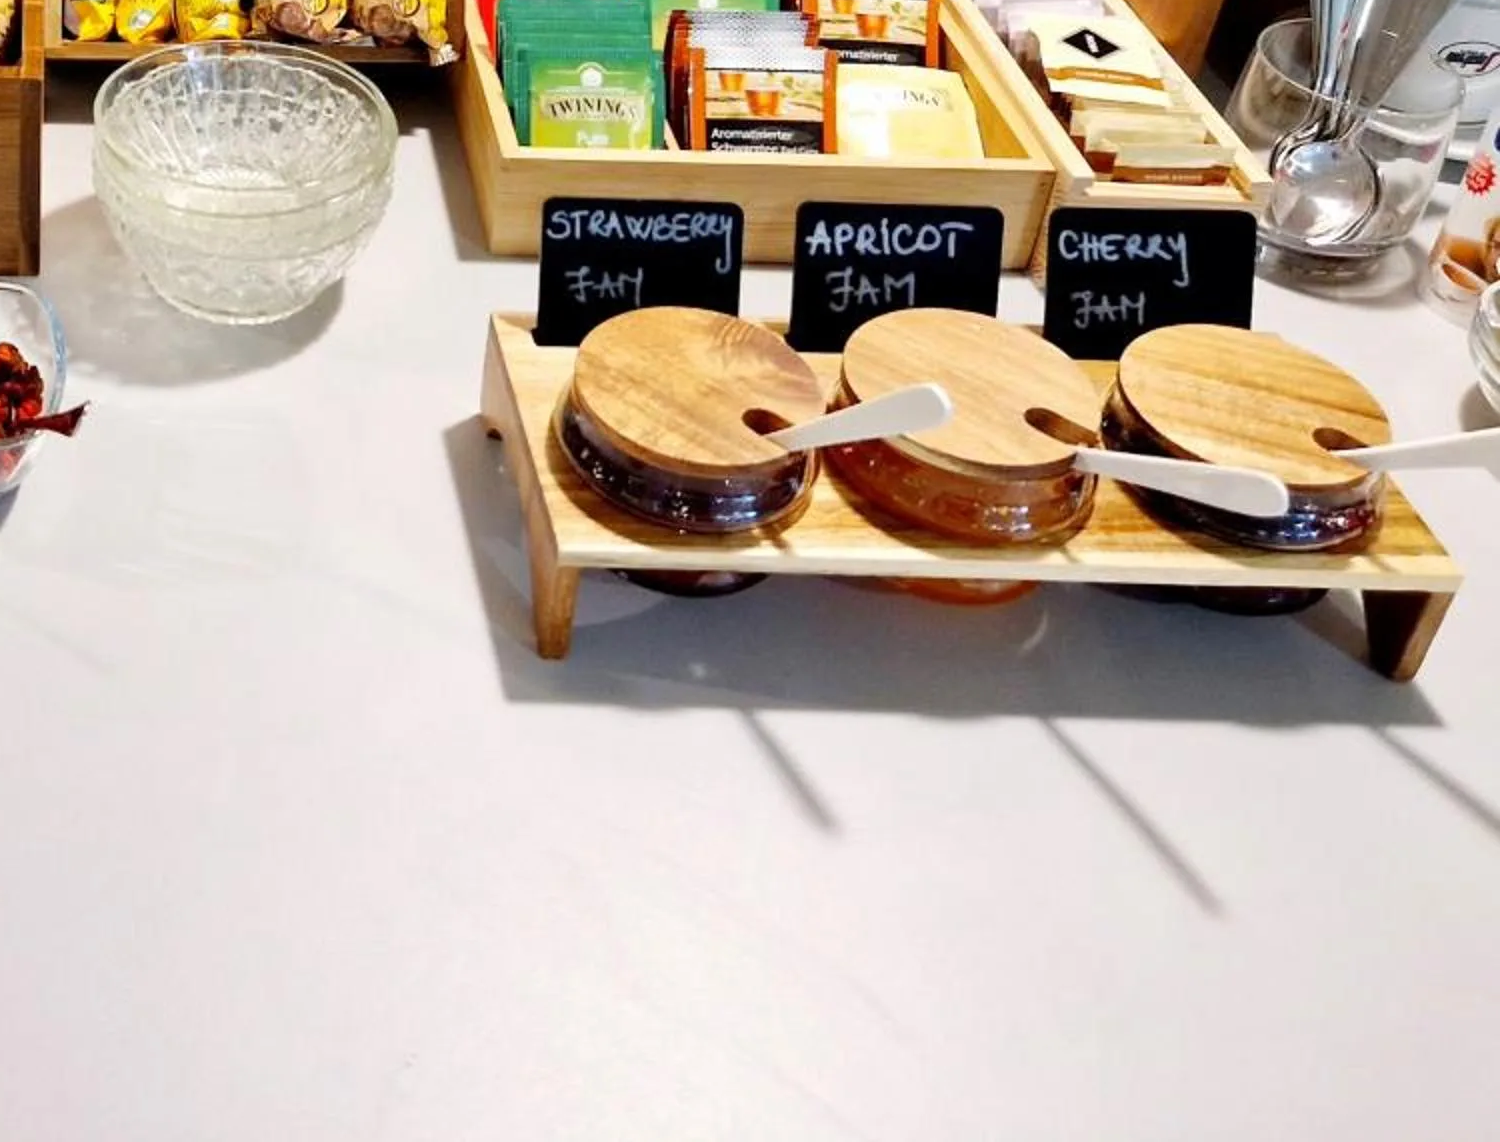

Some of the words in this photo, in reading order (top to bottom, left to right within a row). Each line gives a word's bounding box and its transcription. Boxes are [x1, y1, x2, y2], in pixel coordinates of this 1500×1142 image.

[546, 210, 734, 274] STRAWBERRY
[804, 217, 975, 259] APRICOT
[1058, 229, 1190, 288] CHERRY
[564, 265, 643, 307] JAM
[825, 265, 916, 312] JAM
[1070, 290, 1146, 329] JAM
